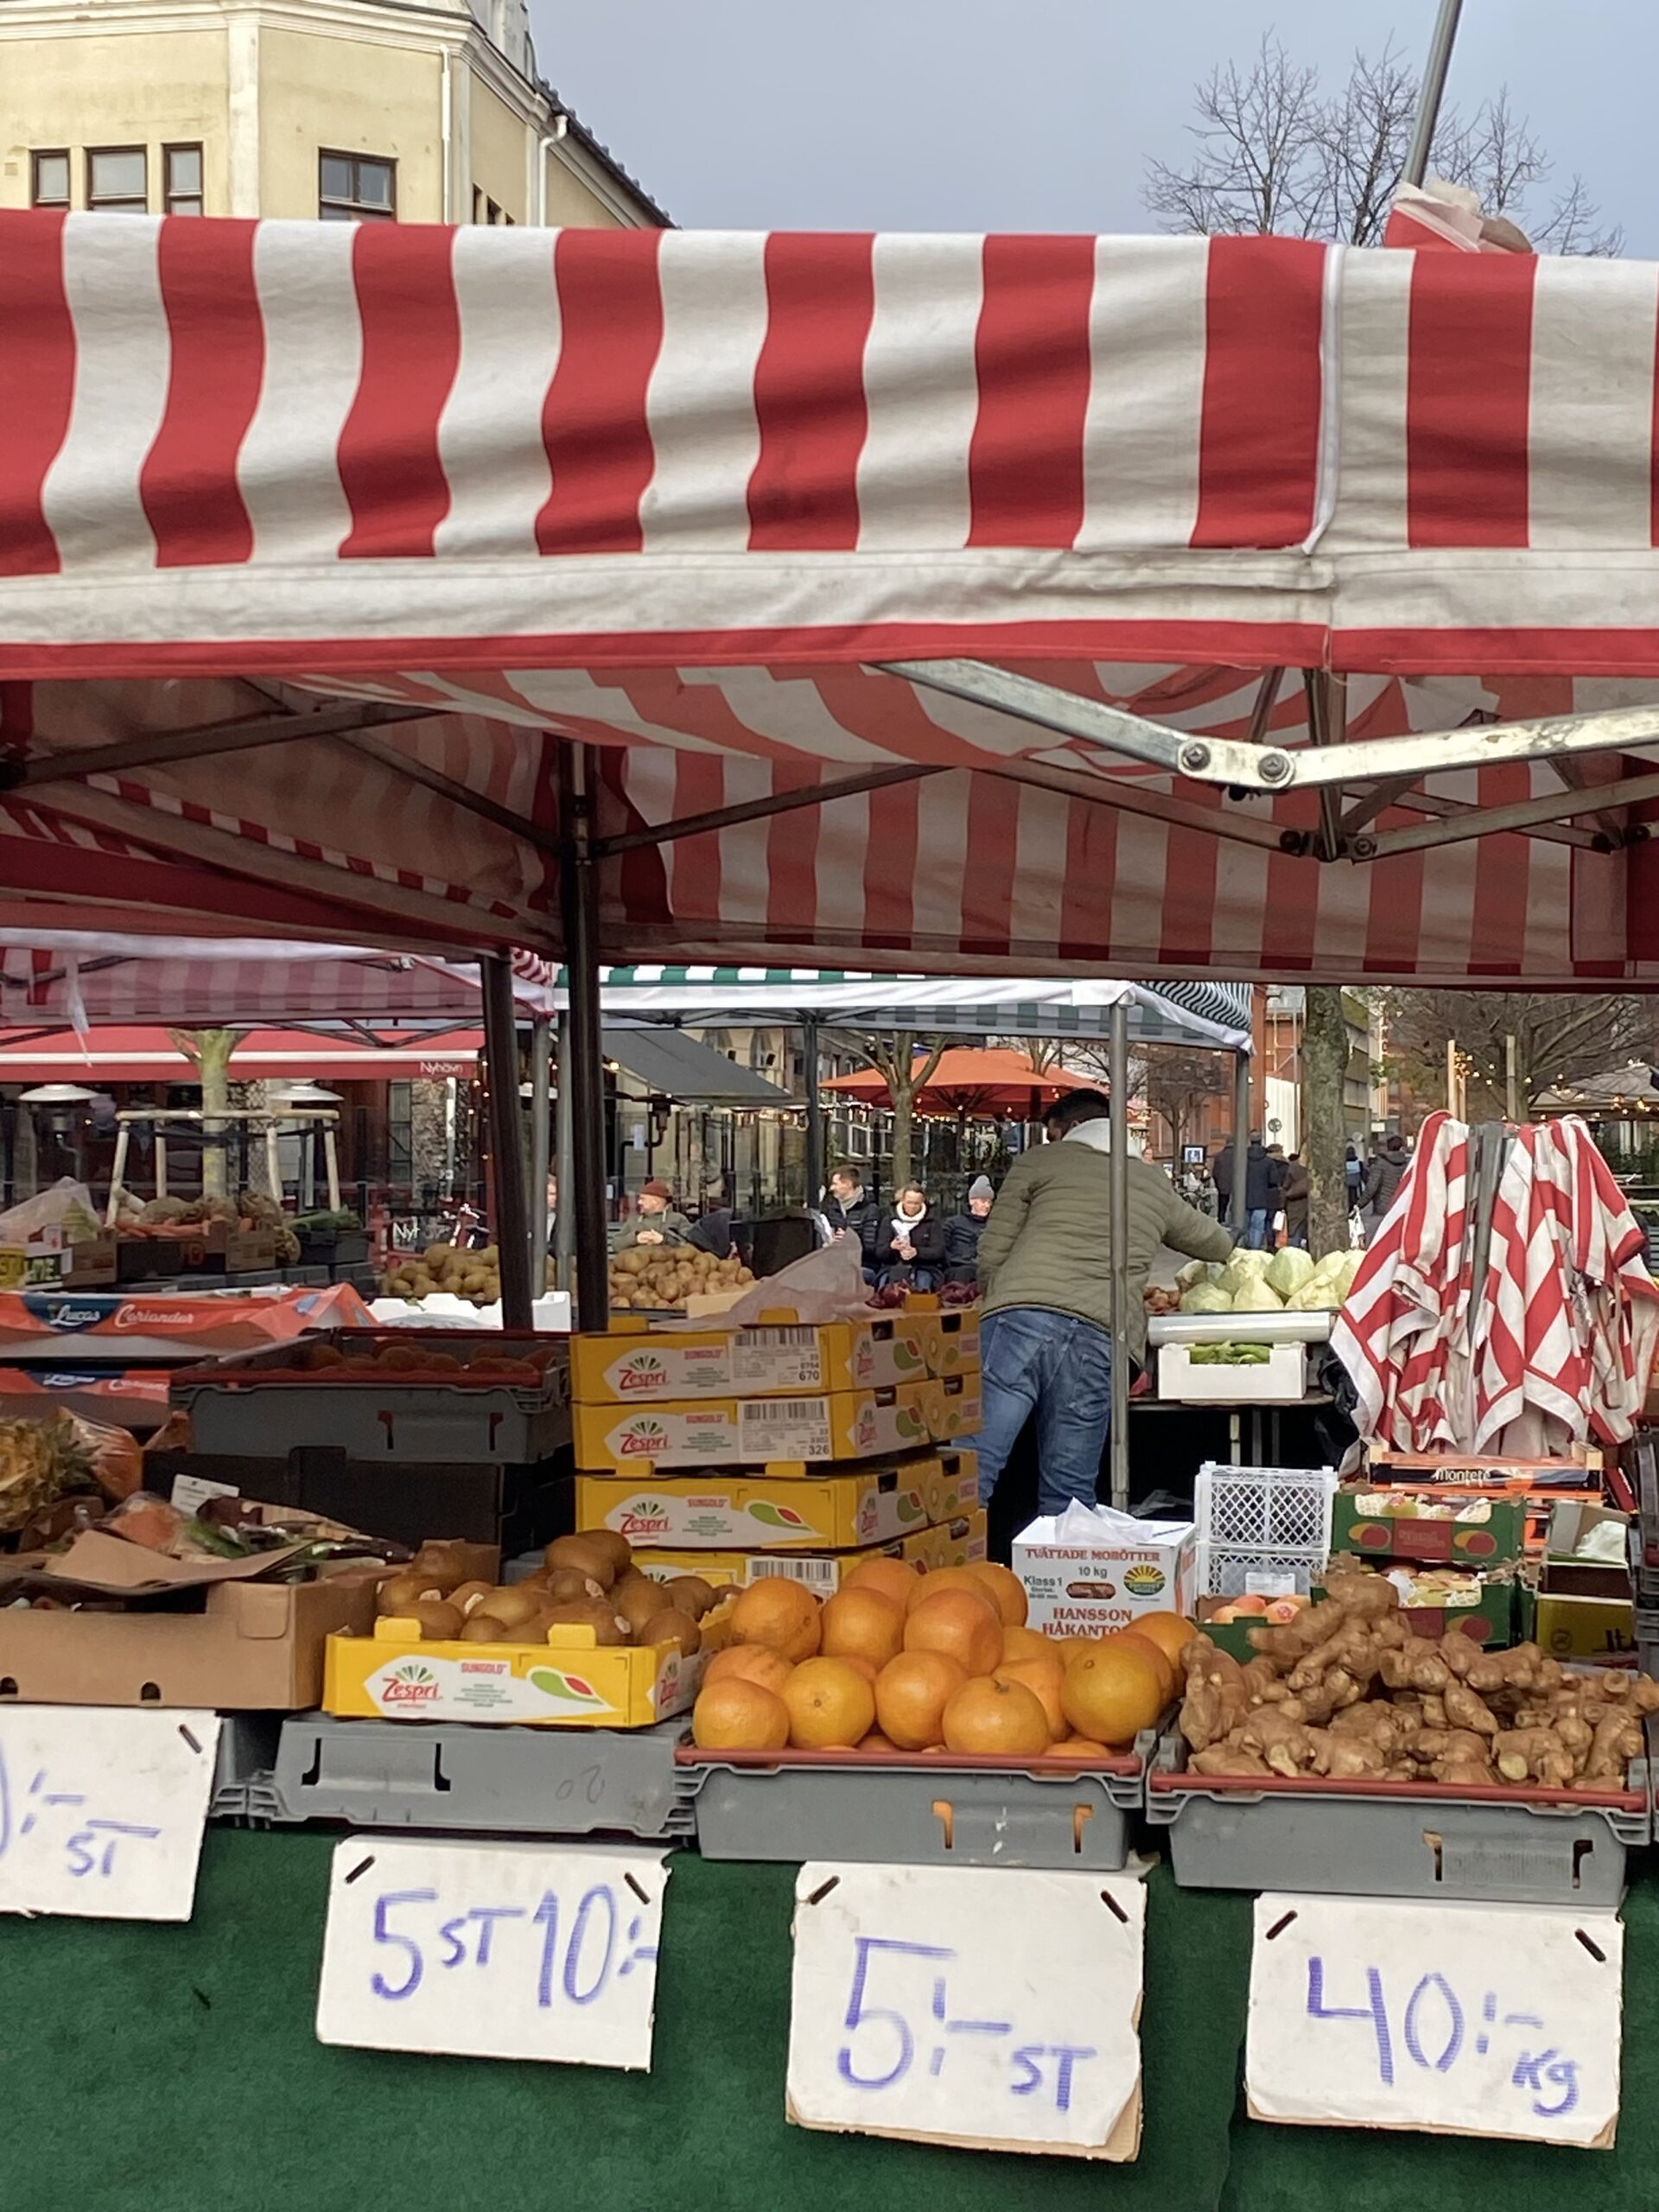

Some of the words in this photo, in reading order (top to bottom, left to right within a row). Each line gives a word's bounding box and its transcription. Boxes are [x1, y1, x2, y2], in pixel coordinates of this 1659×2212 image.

[420, 1061, 463, 1075] Nyhavn
[49, 1304, 100, 1326] Lucas
[618, 1369, 667, 1390] Zespri
[799, 1371, 819, 1381] 670
[620, 1433, 669, 1454] Zespri
[809, 1446, 830, 1455] 326
[620, 1513, 670, 1535] Zespri
[1026, 1547, 1088, 1560] TVÄTTADE
[1024, 1575, 1056, 1586] Klass
[1058, 1577, 1063, 1586] 1
[1078, 1567, 1091, 1576] 10
[1094, 1567, 1108, 1579] kg
[1053, 1607, 1133, 1622] HANSSON
[1042, 1621, 1125, 1637] HÅKANTO
[461, 1662, 505, 1675] SUNGOLD
[383, 1677, 441, 1702] Zespri
[66, 1820, 162, 1877] ST
[371, 1887, 438, 2000] 5
[439, 1907, 526, 1967] ST
[1011, 2044, 1097, 2113] ST
